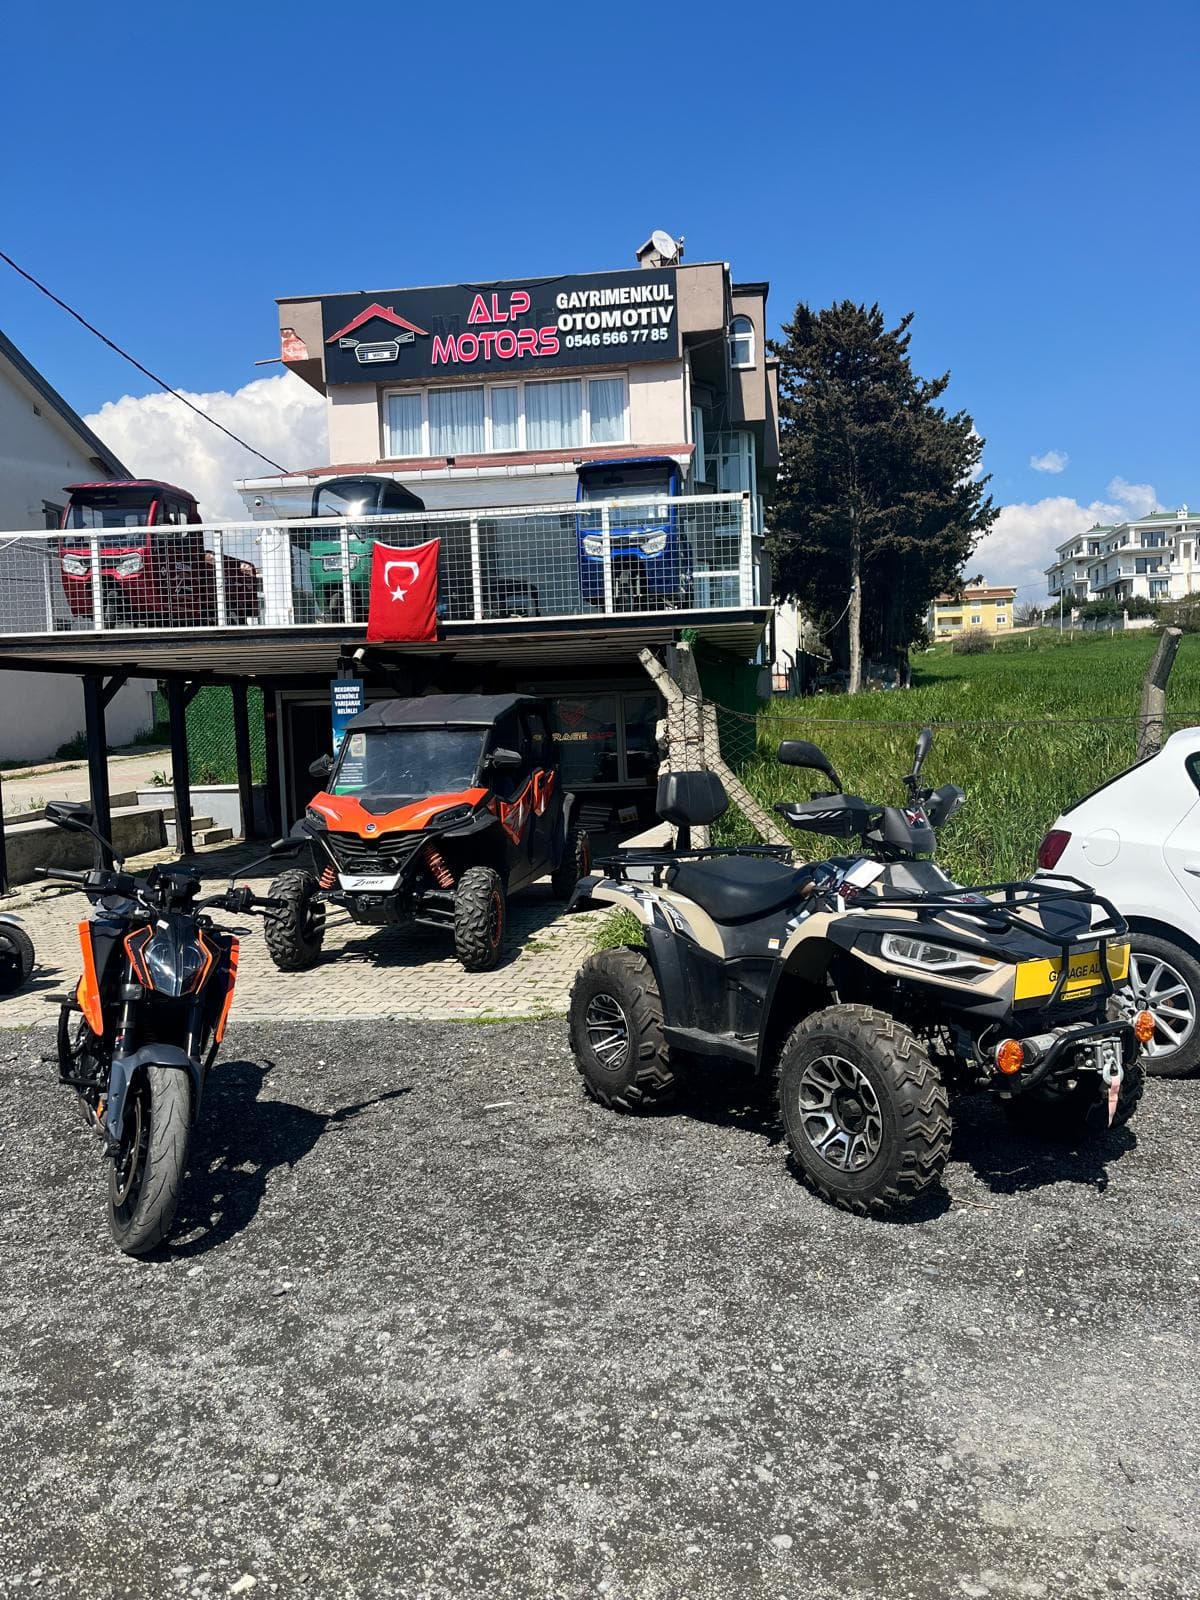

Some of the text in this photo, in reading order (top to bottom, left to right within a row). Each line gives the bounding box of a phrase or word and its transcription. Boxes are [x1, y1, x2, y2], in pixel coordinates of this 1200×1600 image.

[467, 291, 532, 325] ALP
[431, 326, 561, 365] MOTORS
[565, 328, 669, 348] 0546 566 77 85
